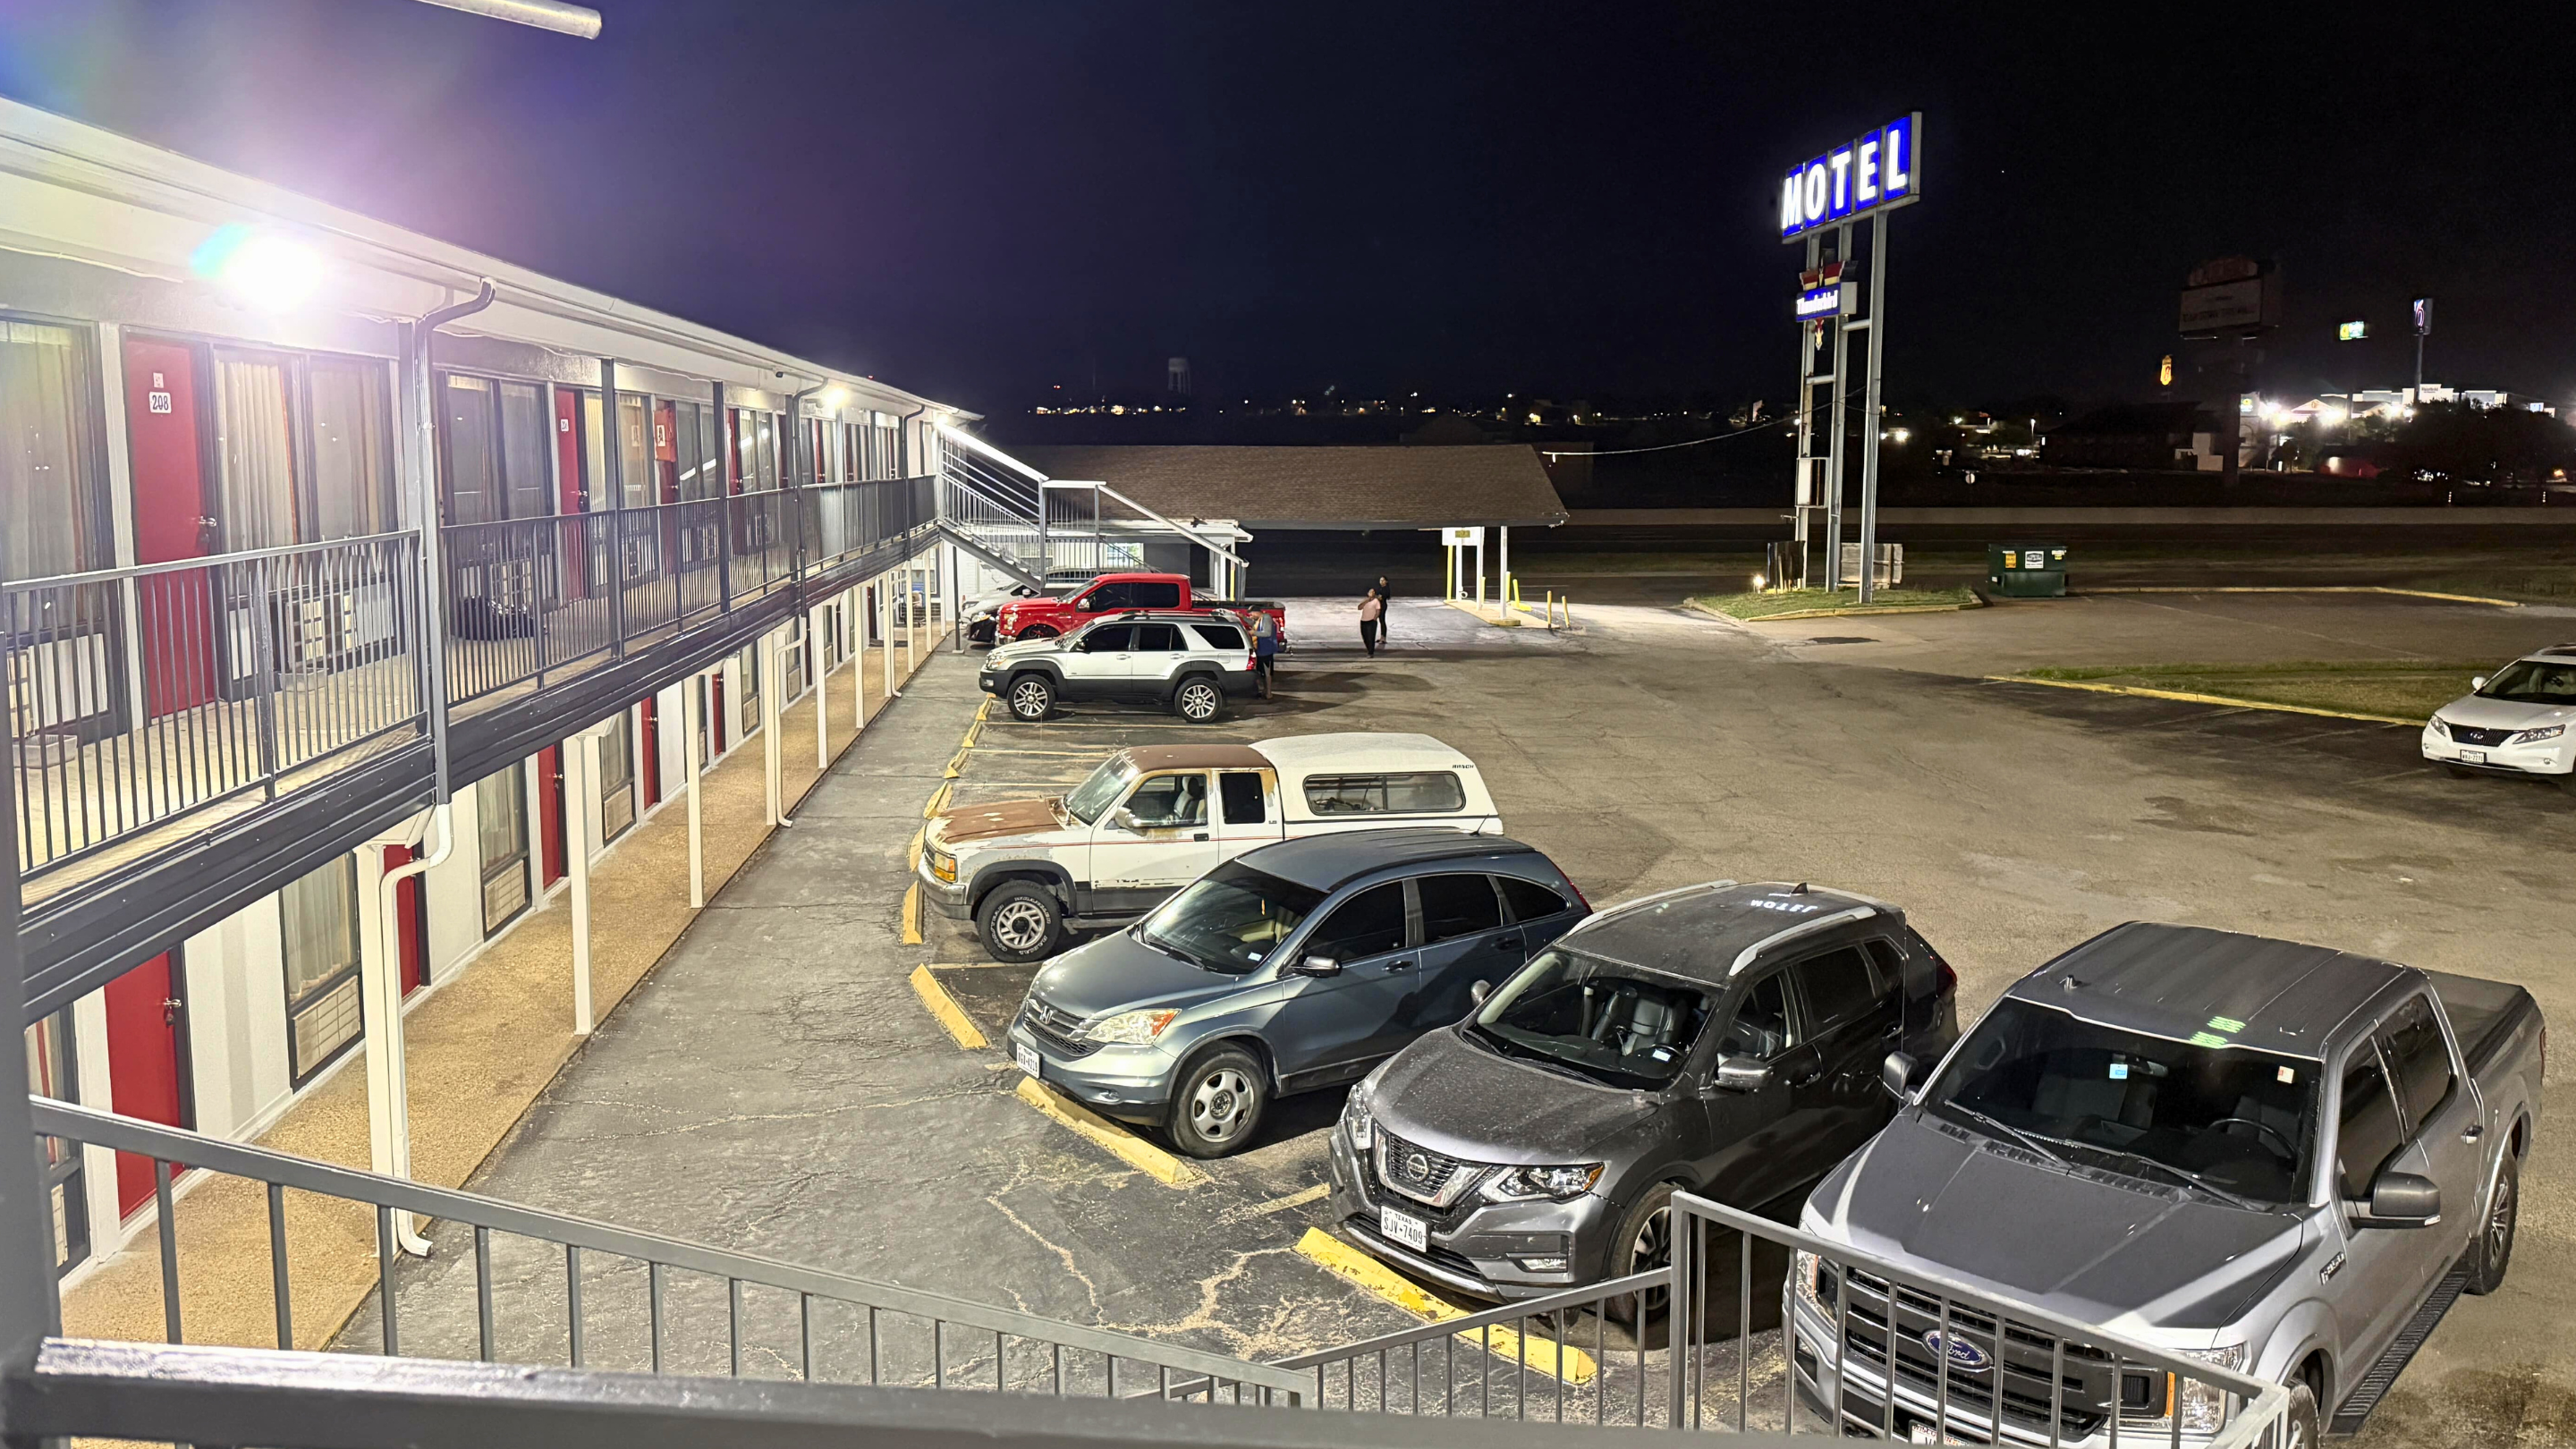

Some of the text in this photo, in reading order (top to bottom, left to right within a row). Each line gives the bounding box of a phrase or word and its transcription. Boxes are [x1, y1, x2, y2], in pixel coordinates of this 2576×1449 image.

[1782, 130, 1907, 229] MOTEL
[152, 394, 168, 411] 208
[1394, 1214, 1411, 1224] TEXAS
